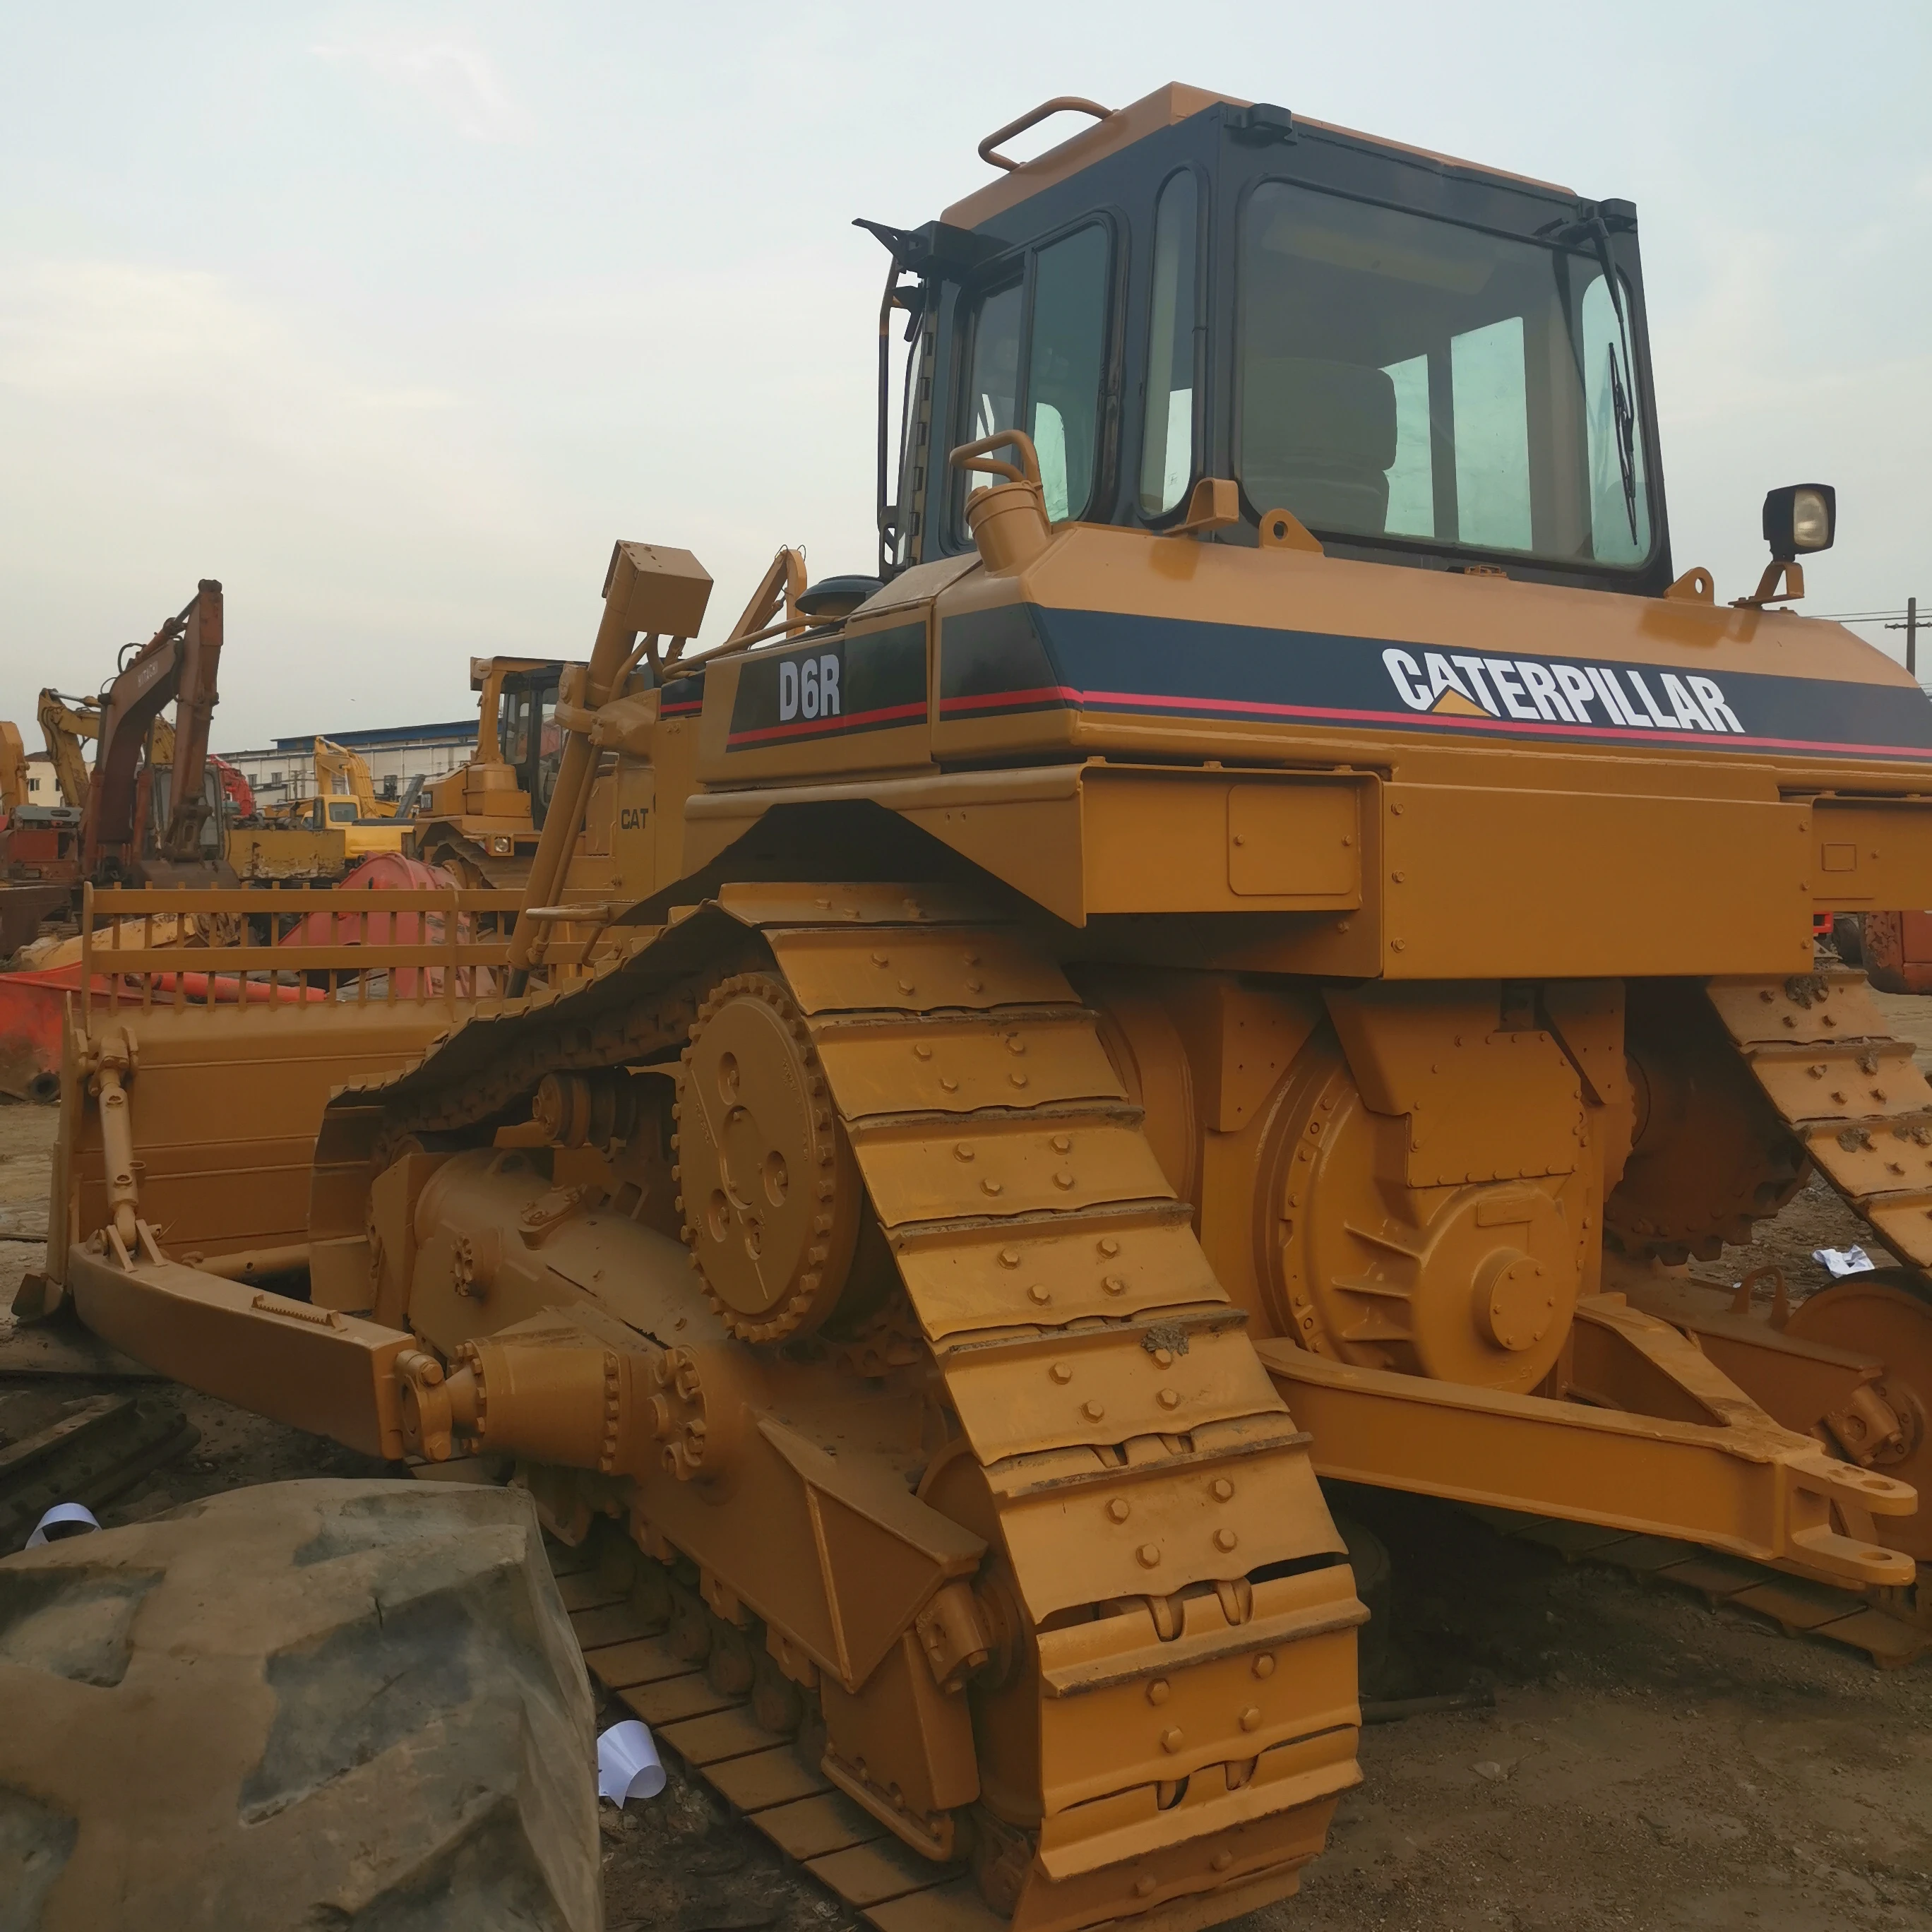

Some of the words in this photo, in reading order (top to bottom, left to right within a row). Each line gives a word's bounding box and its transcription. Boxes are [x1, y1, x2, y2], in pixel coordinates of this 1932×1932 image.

[780, 654, 840, 721] D6R
[1382, 648, 1746, 733] CATERPILLAR
[621, 808, 649, 830] CAT
